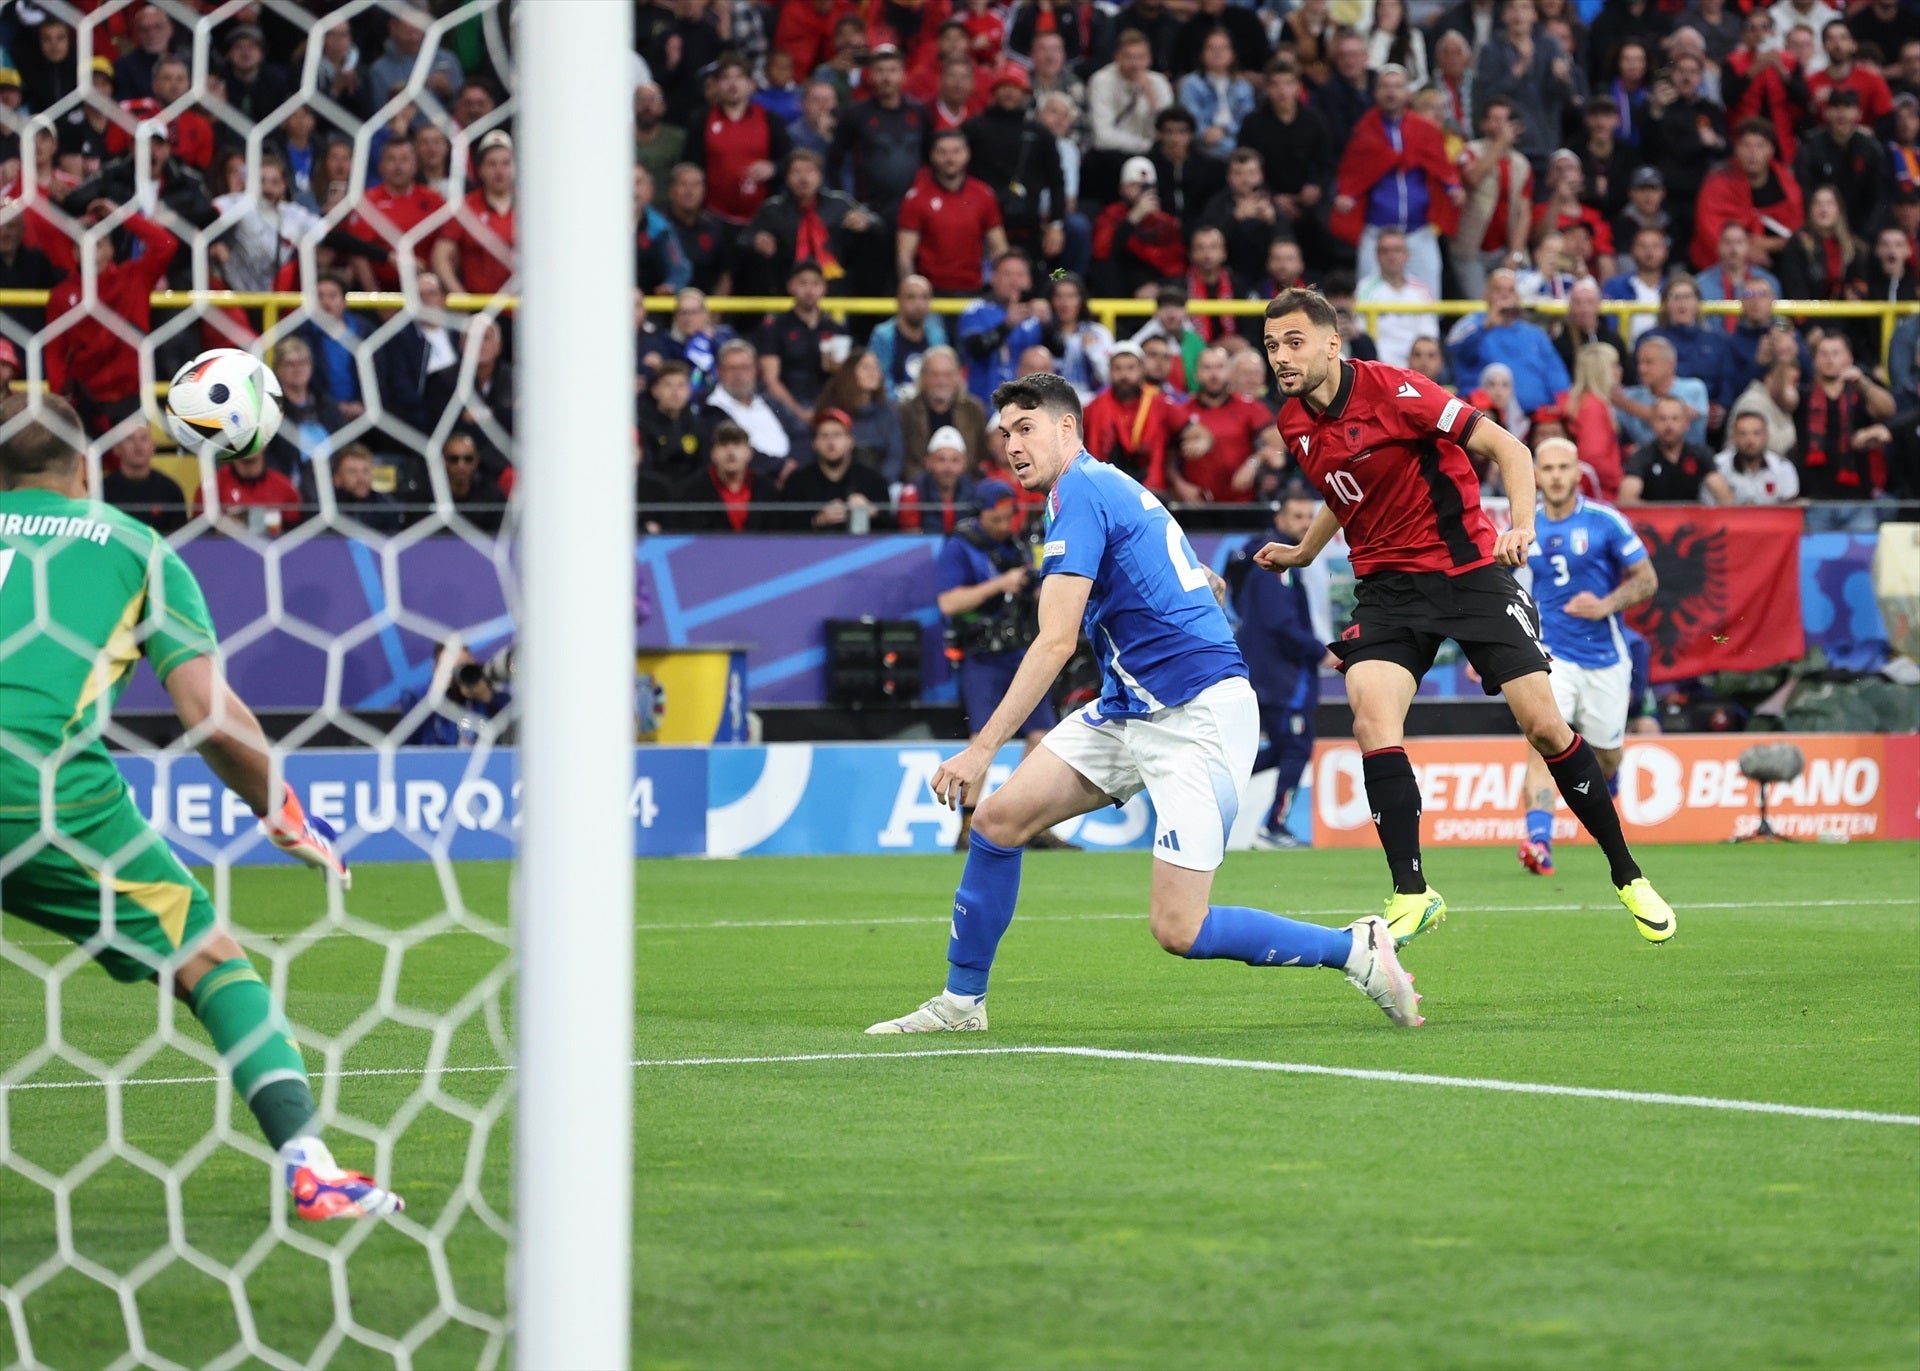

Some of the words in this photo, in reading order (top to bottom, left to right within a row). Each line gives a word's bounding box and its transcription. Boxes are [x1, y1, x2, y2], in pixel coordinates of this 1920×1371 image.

[1324, 470, 1364, 505] 10
[1550, 554, 1570, 587] 3
[1506, 603, 1537, 638] 10
[1687, 758, 1880, 808] BEANO
[128, 782, 266, 836] UEF
[309, 778, 504, 834] EURO
[1434, 817, 1579, 841] SPORTWEEN
